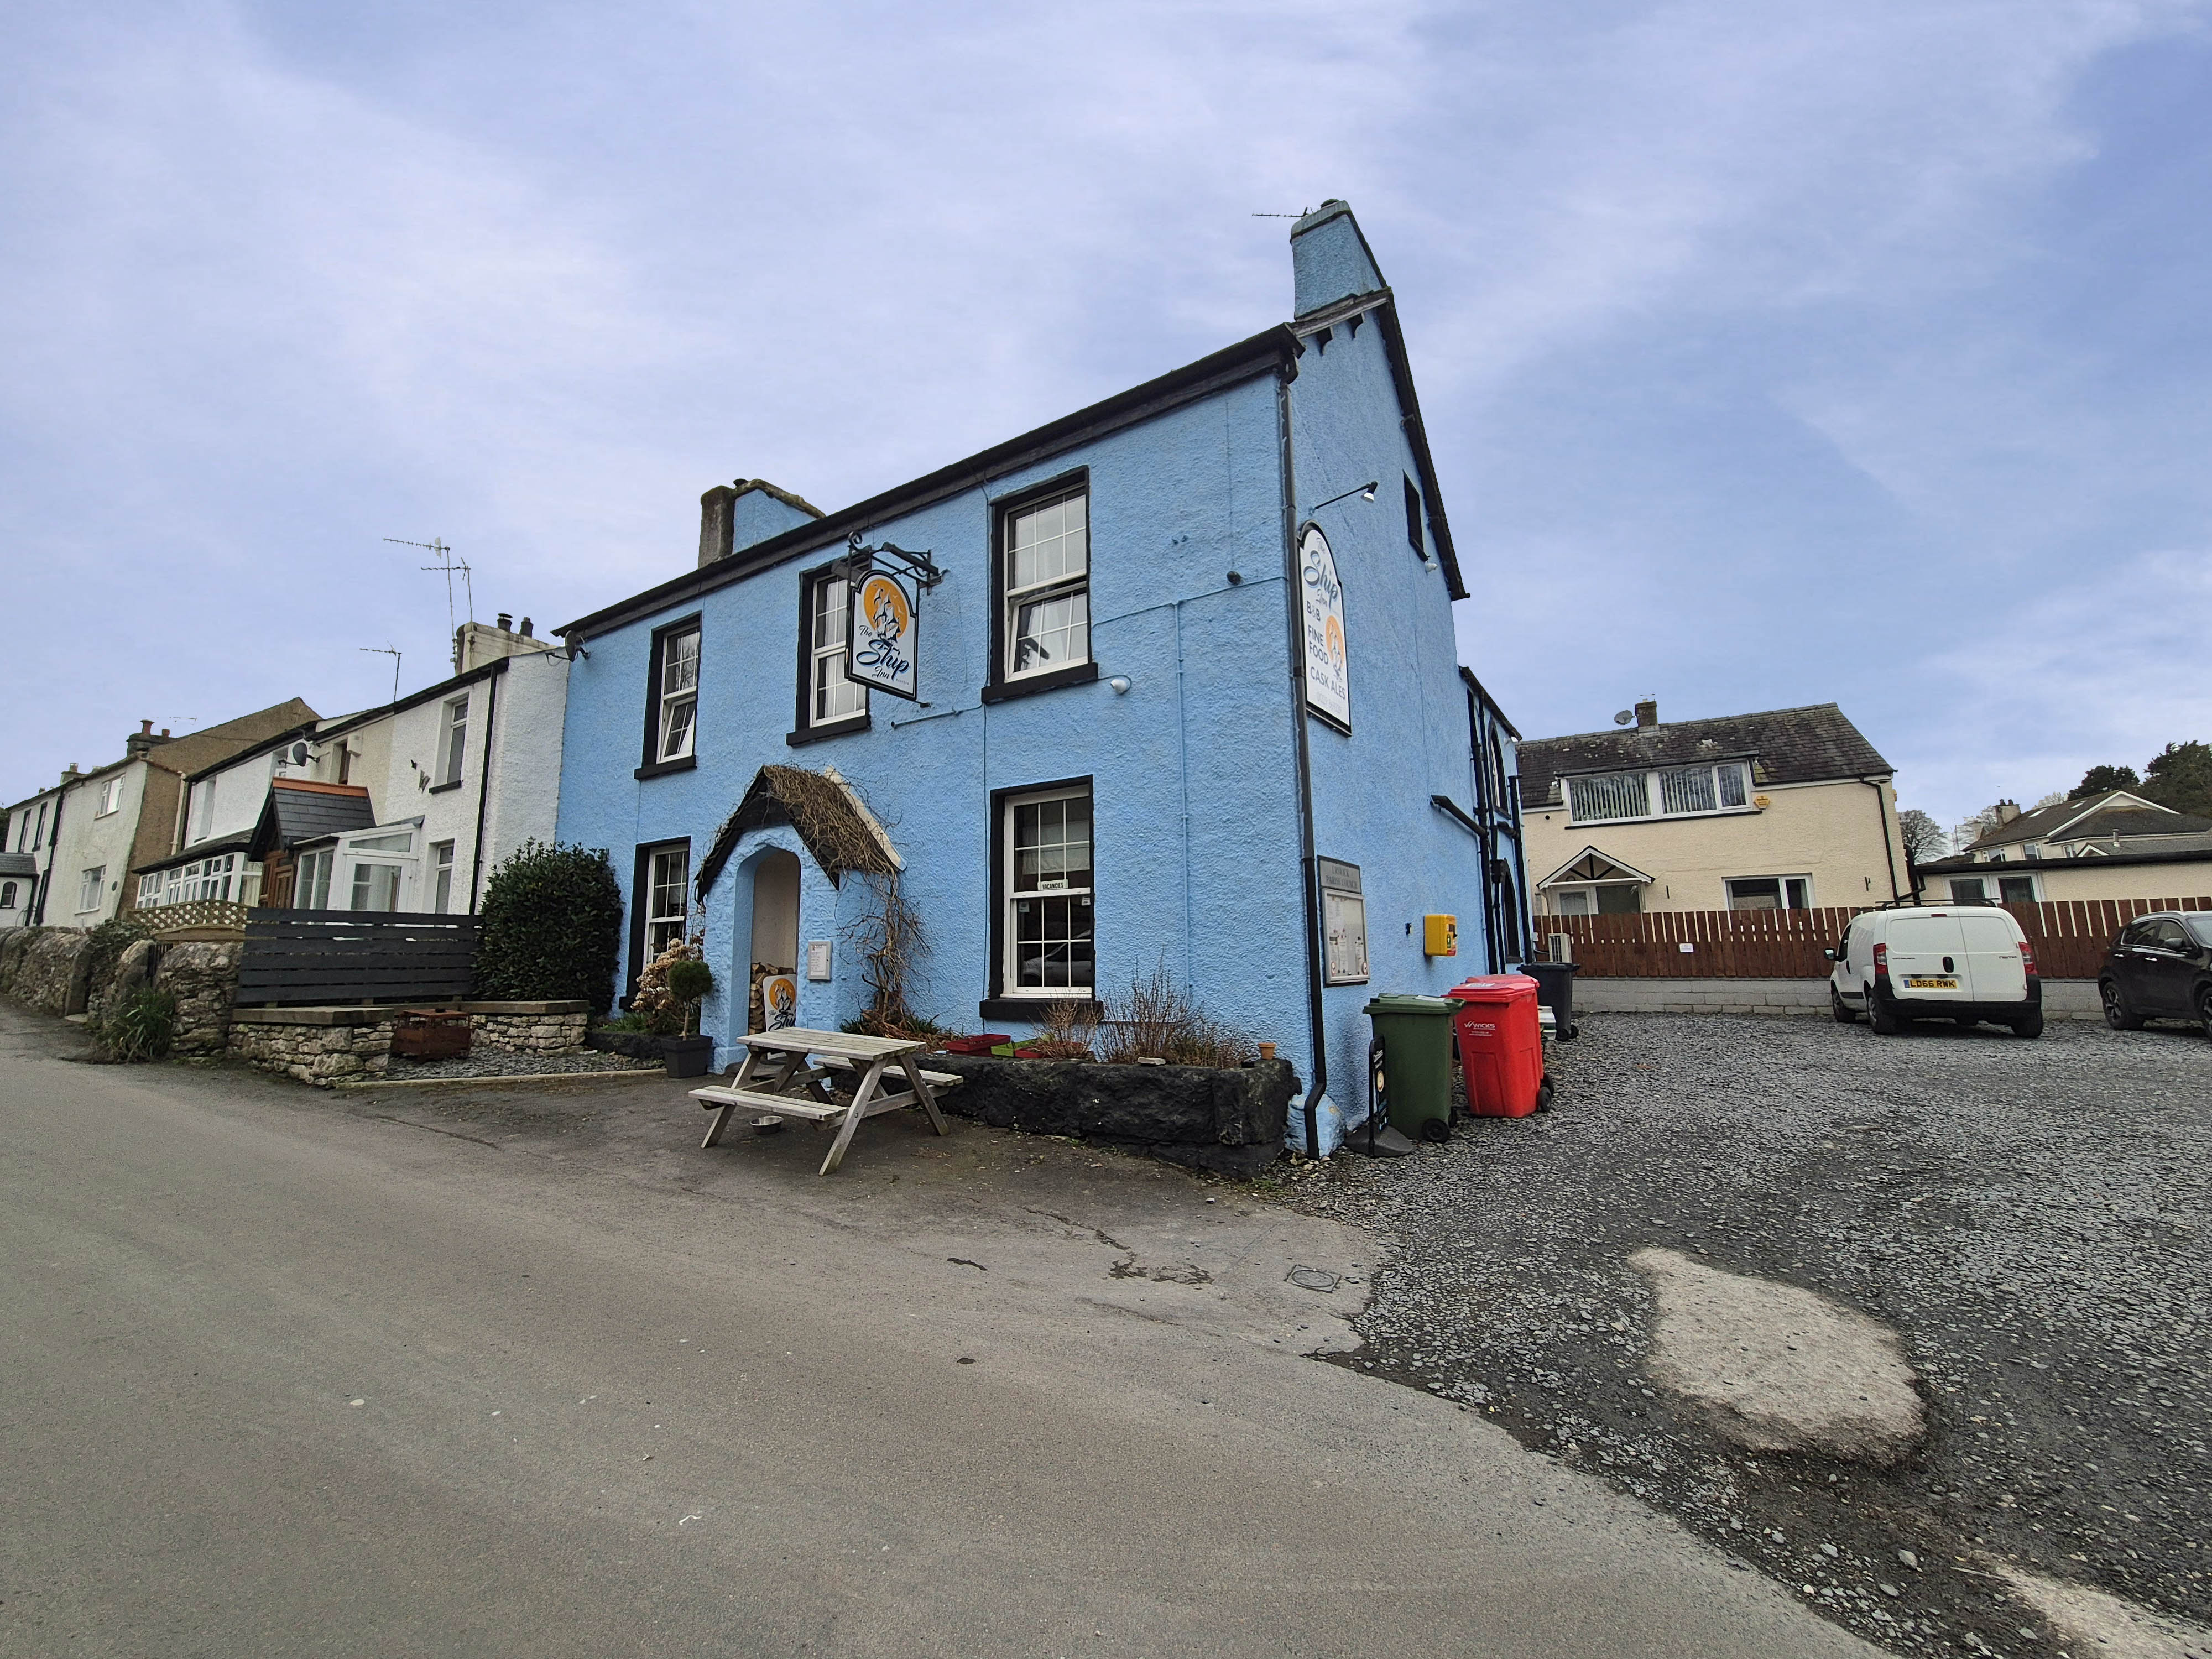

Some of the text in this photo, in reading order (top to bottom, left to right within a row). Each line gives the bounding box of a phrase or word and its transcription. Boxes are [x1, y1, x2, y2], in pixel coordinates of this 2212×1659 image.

[1303, 550, 1338, 611] Ship
[859, 625, 873, 637] The
[1308, 624, 1324, 647] FINE
[855, 639, 910, 681] Ship
[1309, 641, 1329, 665] FOOD
[872, 665, 890, 679] Inn
[1310, 666, 1345, 700] CASK ALES
